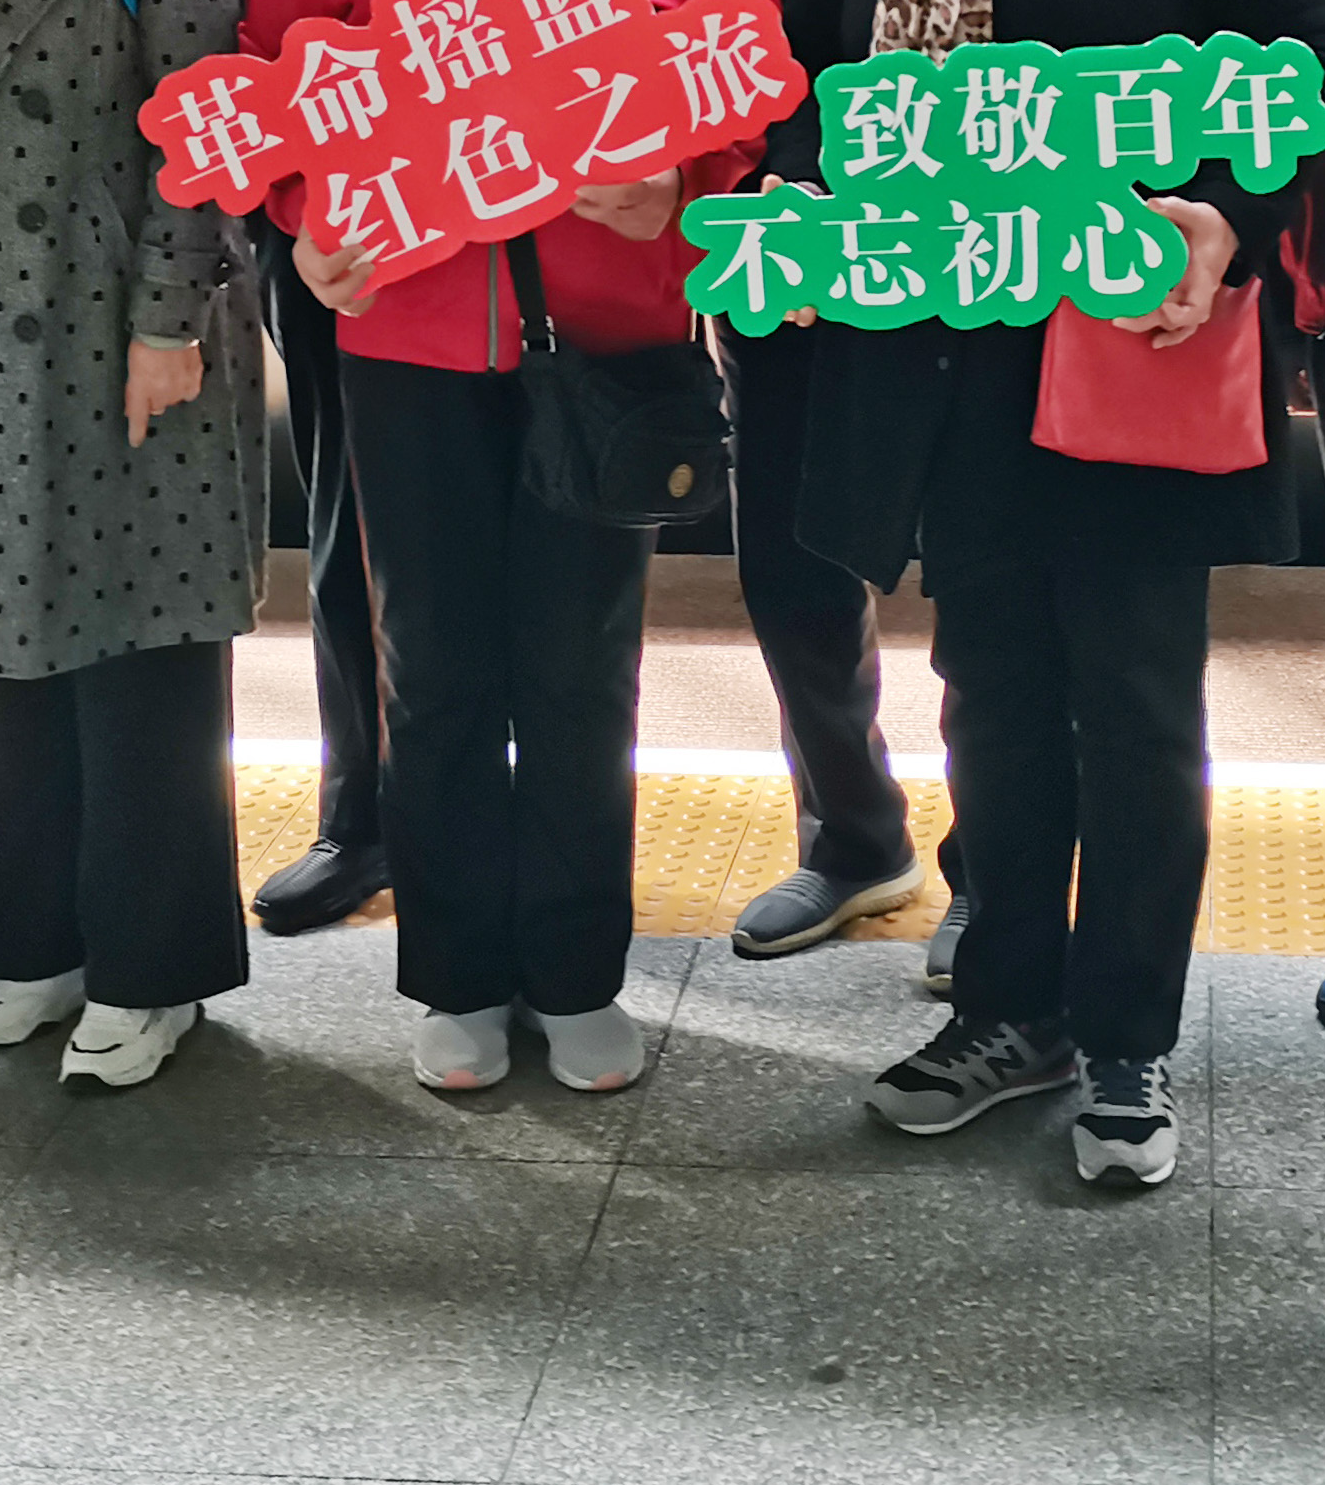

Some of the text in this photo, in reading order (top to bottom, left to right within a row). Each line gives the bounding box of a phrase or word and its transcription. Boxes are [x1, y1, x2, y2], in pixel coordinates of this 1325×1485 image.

[325, 12, 786, 265] 红色之旅
[837, 57, 1310, 181] 致敬百年
[702, 200, 1164, 314] 不忘初心
